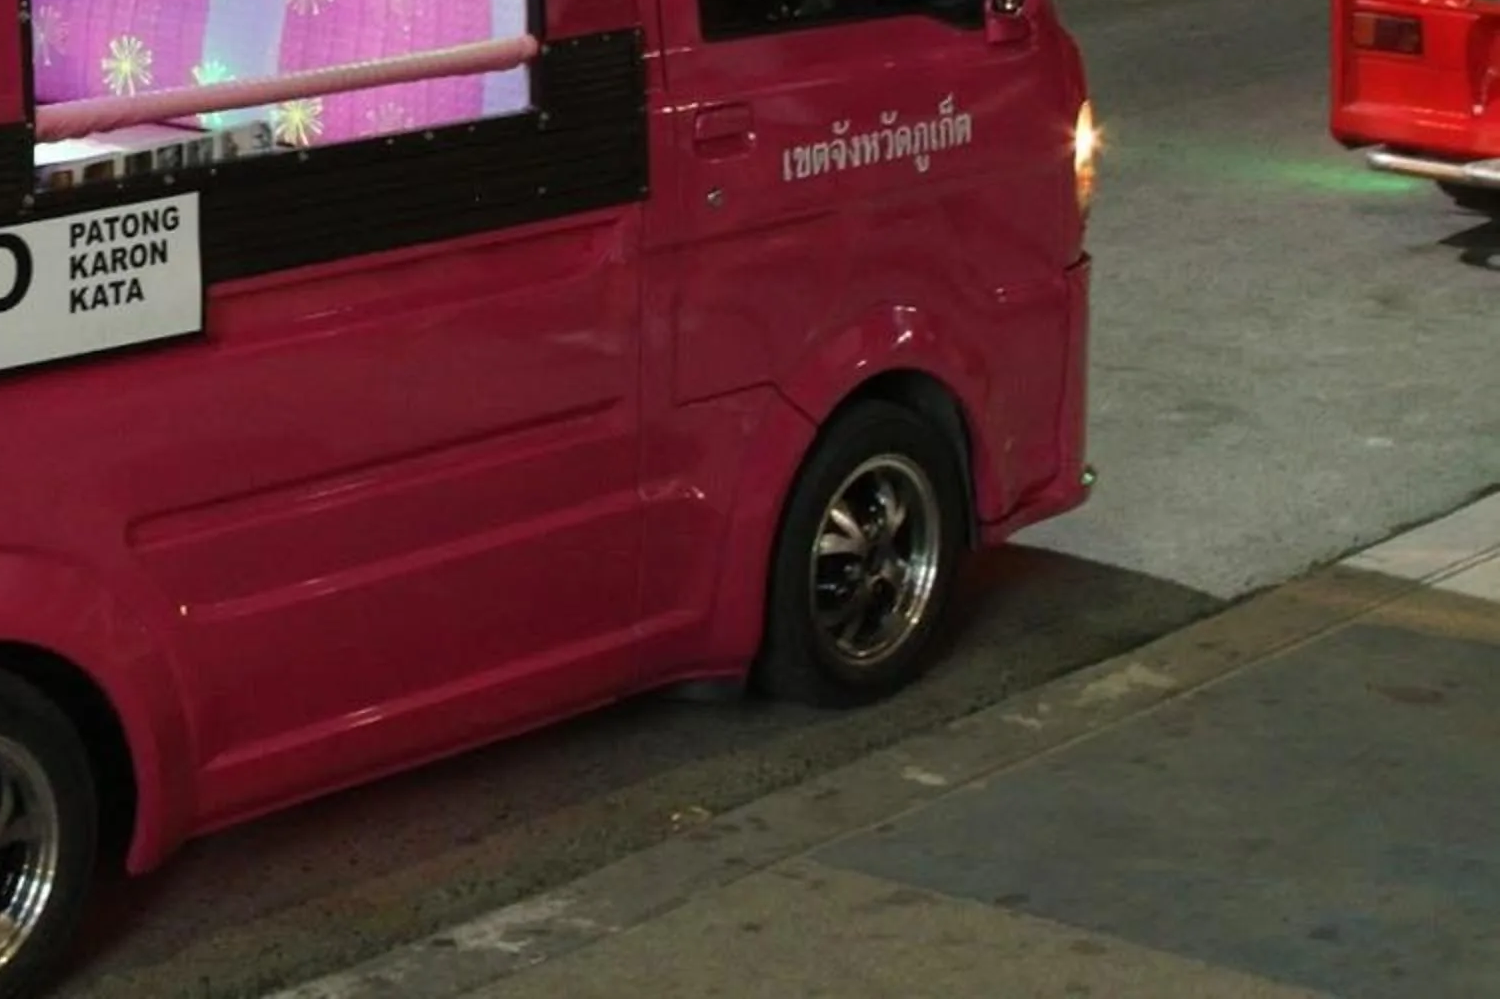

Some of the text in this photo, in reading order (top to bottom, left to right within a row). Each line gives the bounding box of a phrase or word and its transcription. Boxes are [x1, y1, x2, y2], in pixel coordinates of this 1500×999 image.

[69, 205, 181, 249] PATONG
[69, 238, 168, 281] KARON
[69, 277, 145, 314] KATA
